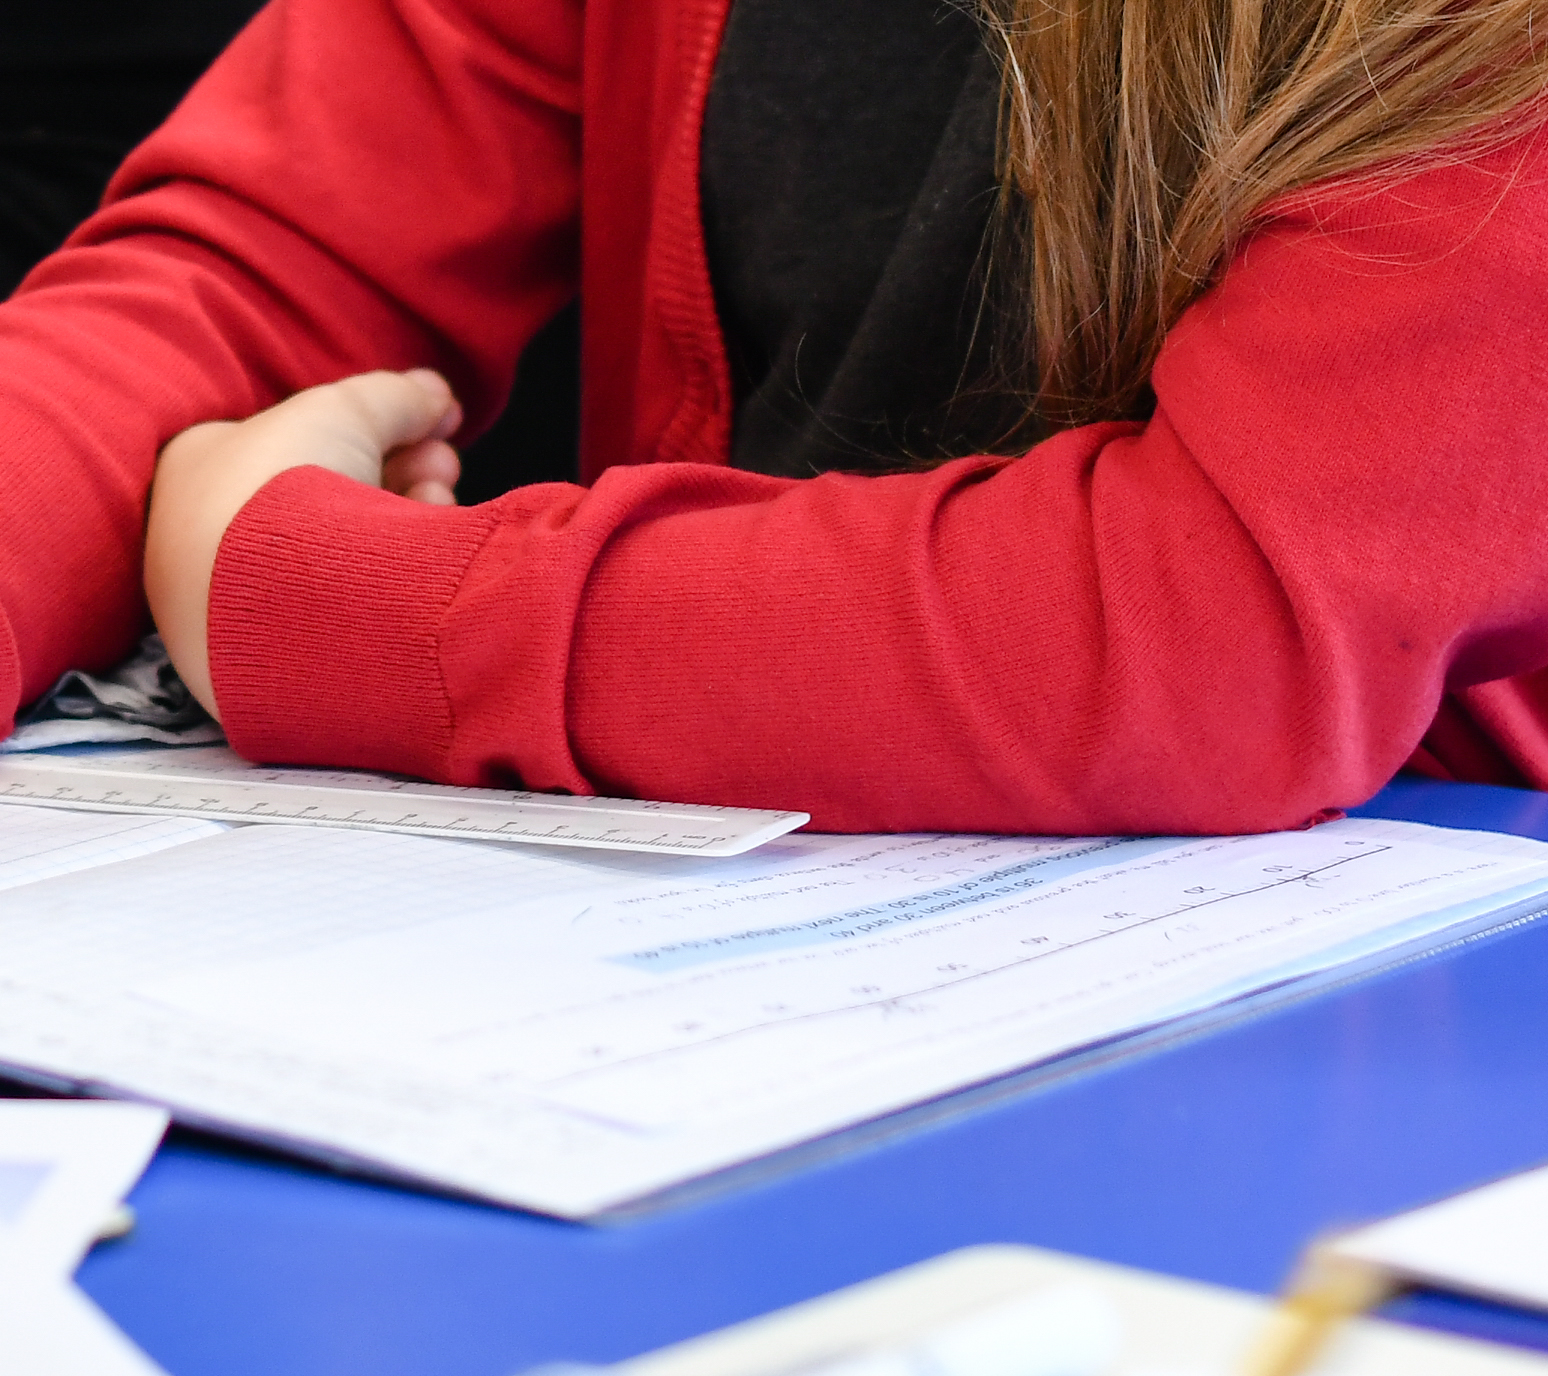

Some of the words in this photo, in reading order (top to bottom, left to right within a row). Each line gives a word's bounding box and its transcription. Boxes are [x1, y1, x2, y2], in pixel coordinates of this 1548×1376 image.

[1262, 863, 1293, 874] 10
[933, 886, 959, 897] 10
[922, 890, 1000, 914] between
[845, 906, 884, 919] The
[856, 916, 892, 933] and
